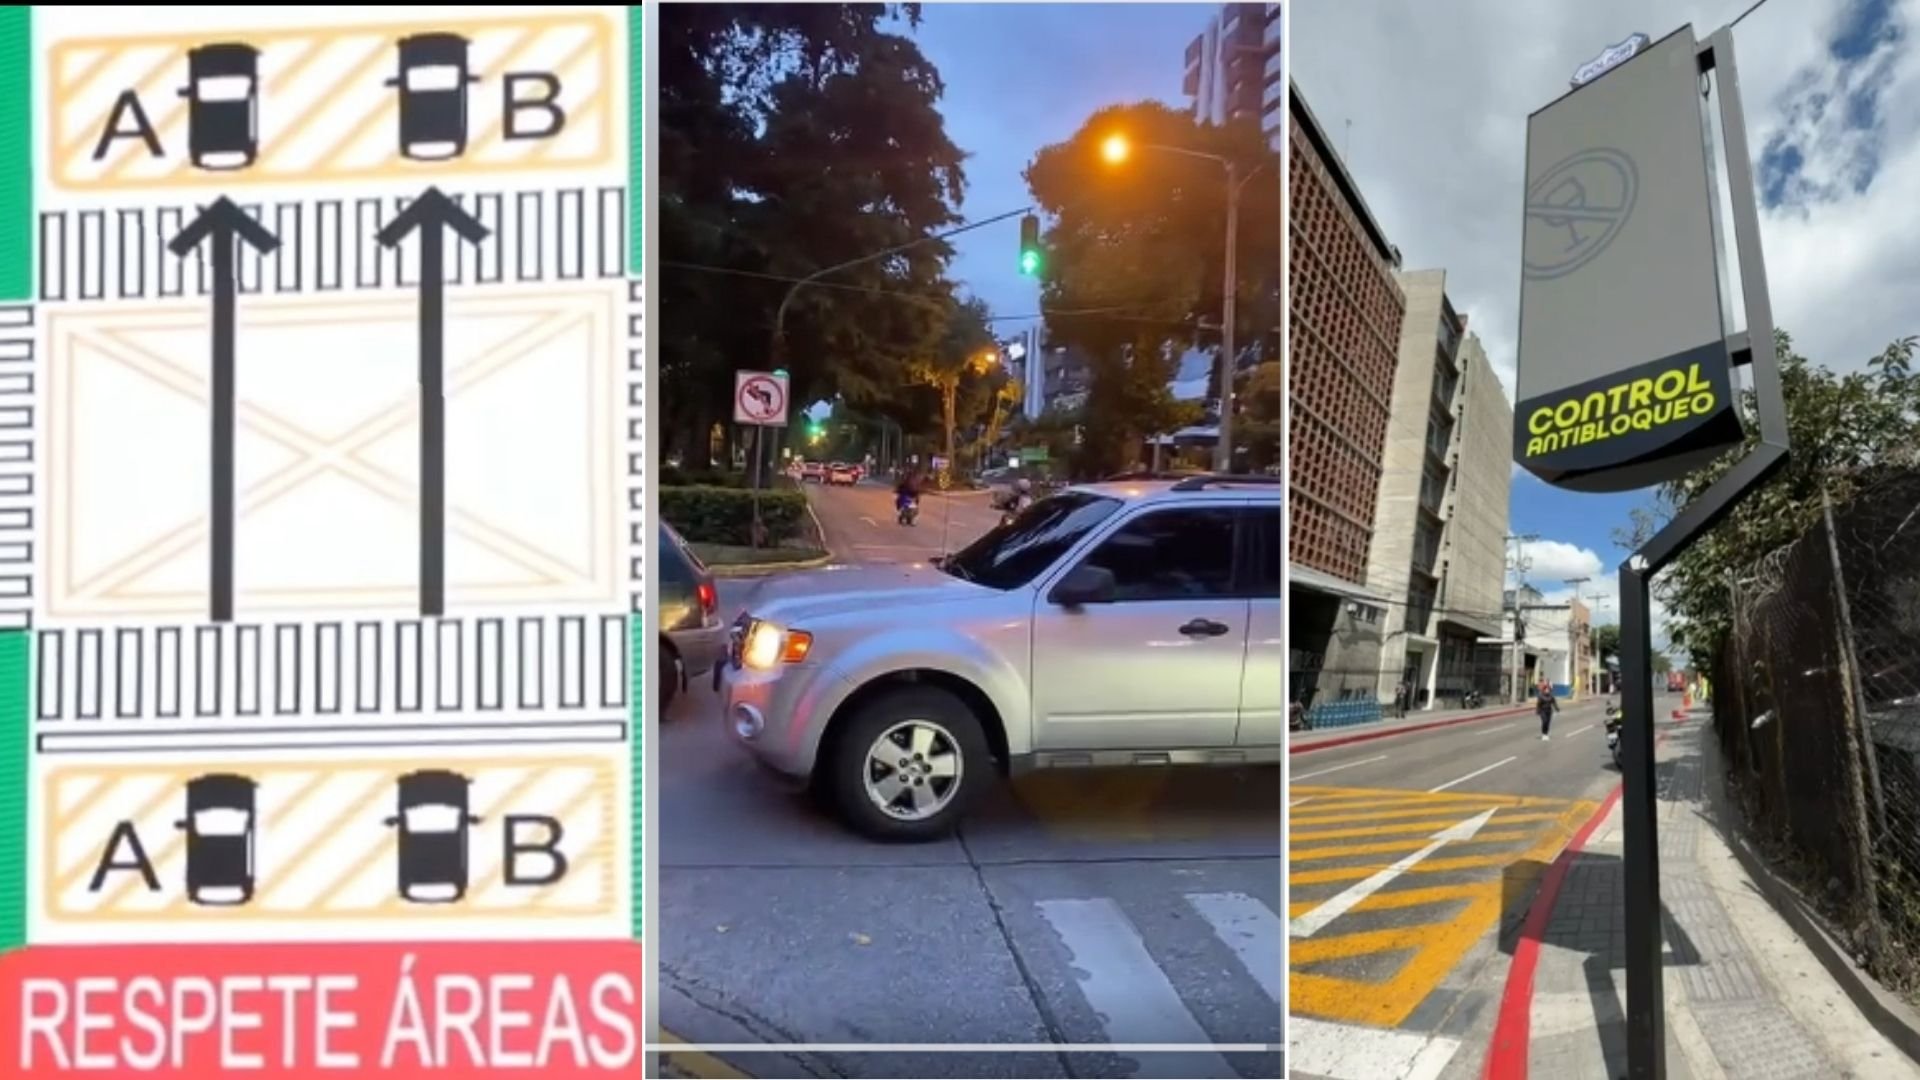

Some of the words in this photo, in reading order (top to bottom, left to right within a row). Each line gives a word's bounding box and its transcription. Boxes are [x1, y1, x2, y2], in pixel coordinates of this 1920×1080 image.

[93, 89, 163, 160] A
[502, 72, 566, 141] B
[1526, 391, 1715, 457] ANTIBLOQUEO
[1528, 363, 1711, 435] CONTROL
[88, 820, 161, 892] A
[503, 814, 568, 886] B
[20, 976, 360, 1069] RESPETE
[379, 953, 636, 1069] ÁREAS
